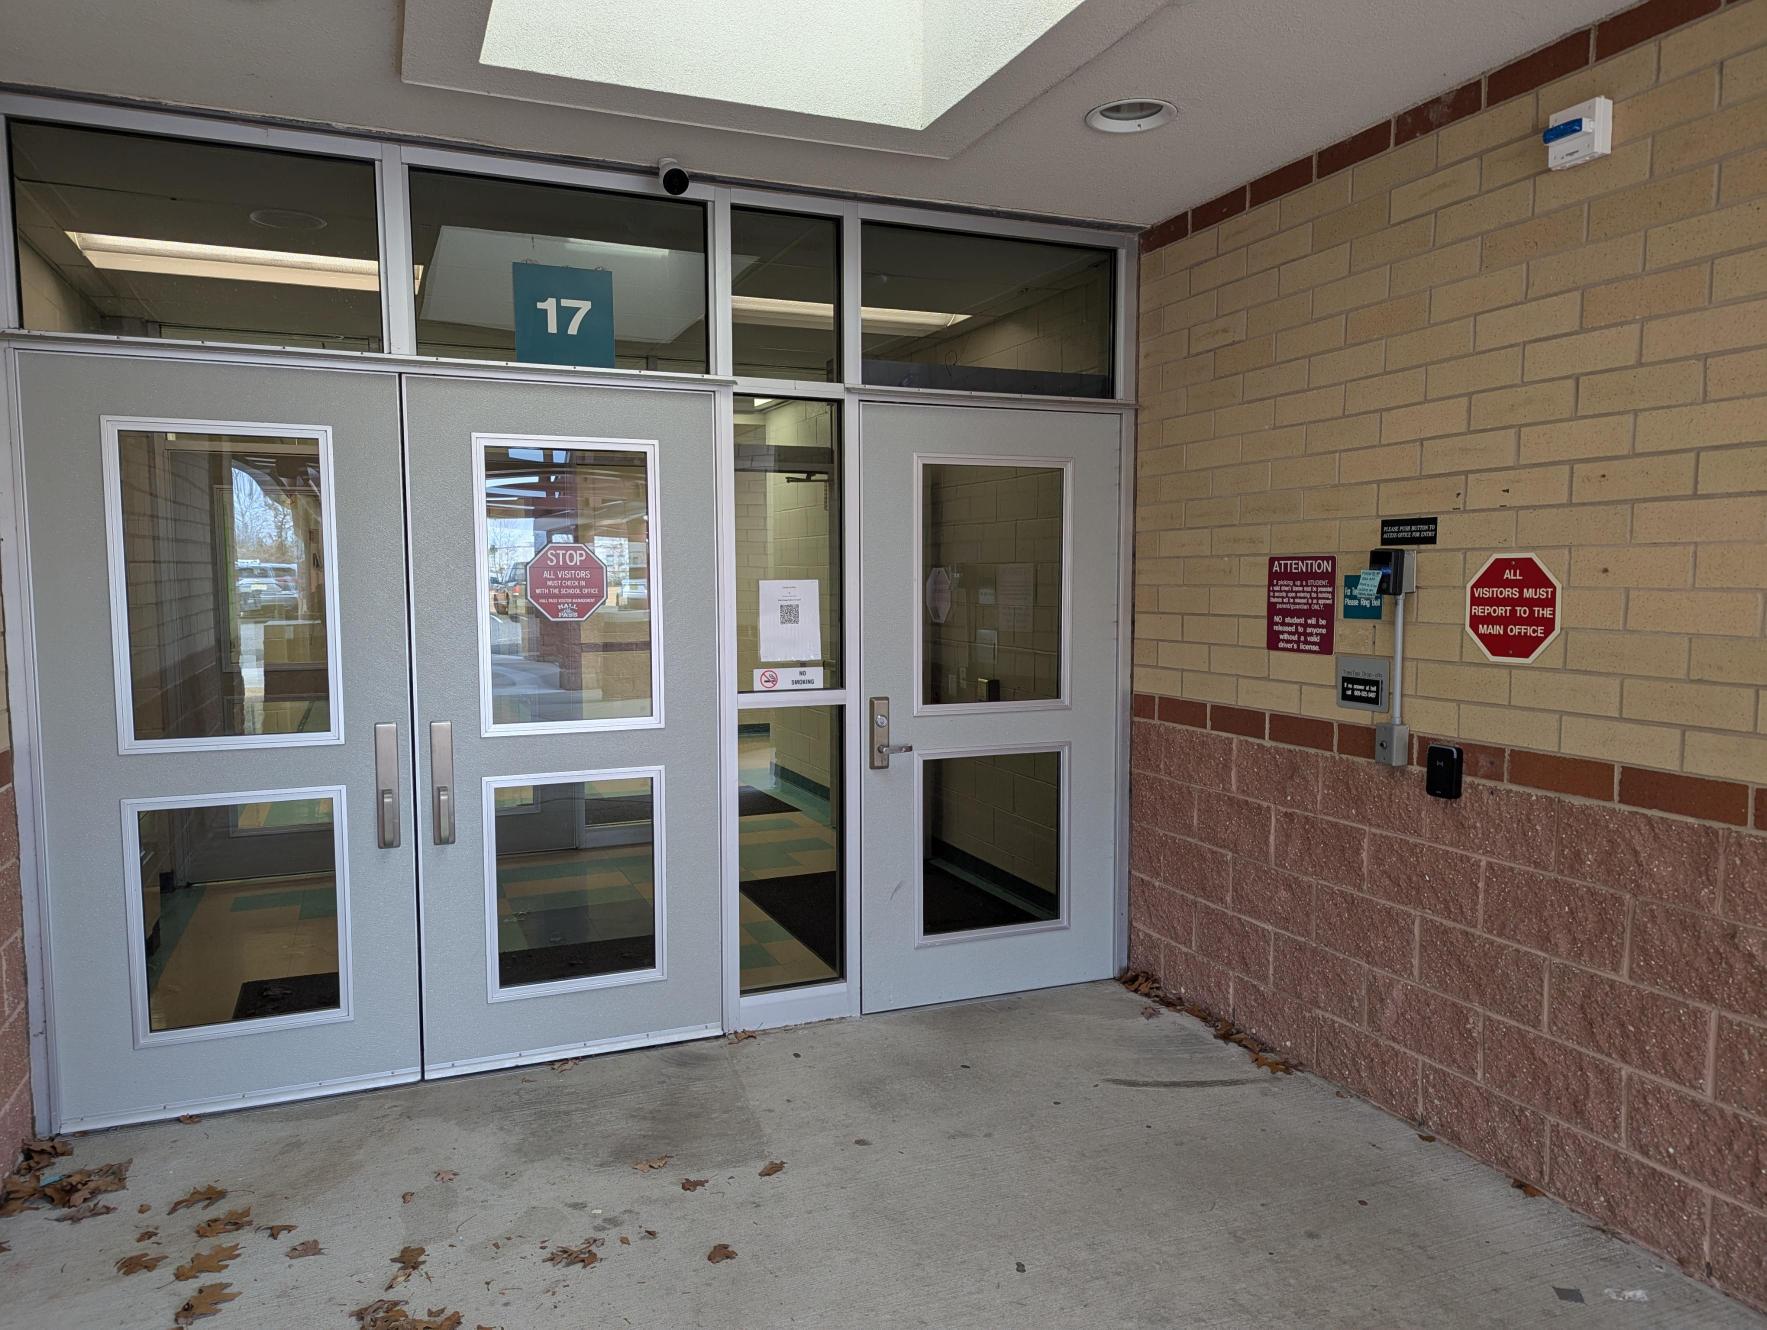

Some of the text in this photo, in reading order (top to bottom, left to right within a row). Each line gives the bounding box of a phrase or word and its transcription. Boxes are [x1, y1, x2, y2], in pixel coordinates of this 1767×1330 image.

[536, 297, 592, 335] 17
[547, 550, 586, 566] STOP
[1272, 560, 1332, 573] ATTENTION
[543, 570, 591, 579] ALL VISITORS
[1503, 569, 1523, 580] ALL
[1473, 587, 1553, 599] VISITORS MUST
[1344, 598, 1359, 606] Please
[1360, 598, 1371, 608] Ring
[1471, 605, 1554, 618] REPORT TO THE
[1273, 615, 1327, 626] NO student will be
[1306, 627, 1327, 635] anyone
[1478, 624, 1545, 637] MAIN OFFICE
[1279, 633, 1298, 641] without
[1306, 635, 1320, 643] valid
[1278, 641, 1321, 651] driver's license.
[791, 678, 815, 686] SMOKING
